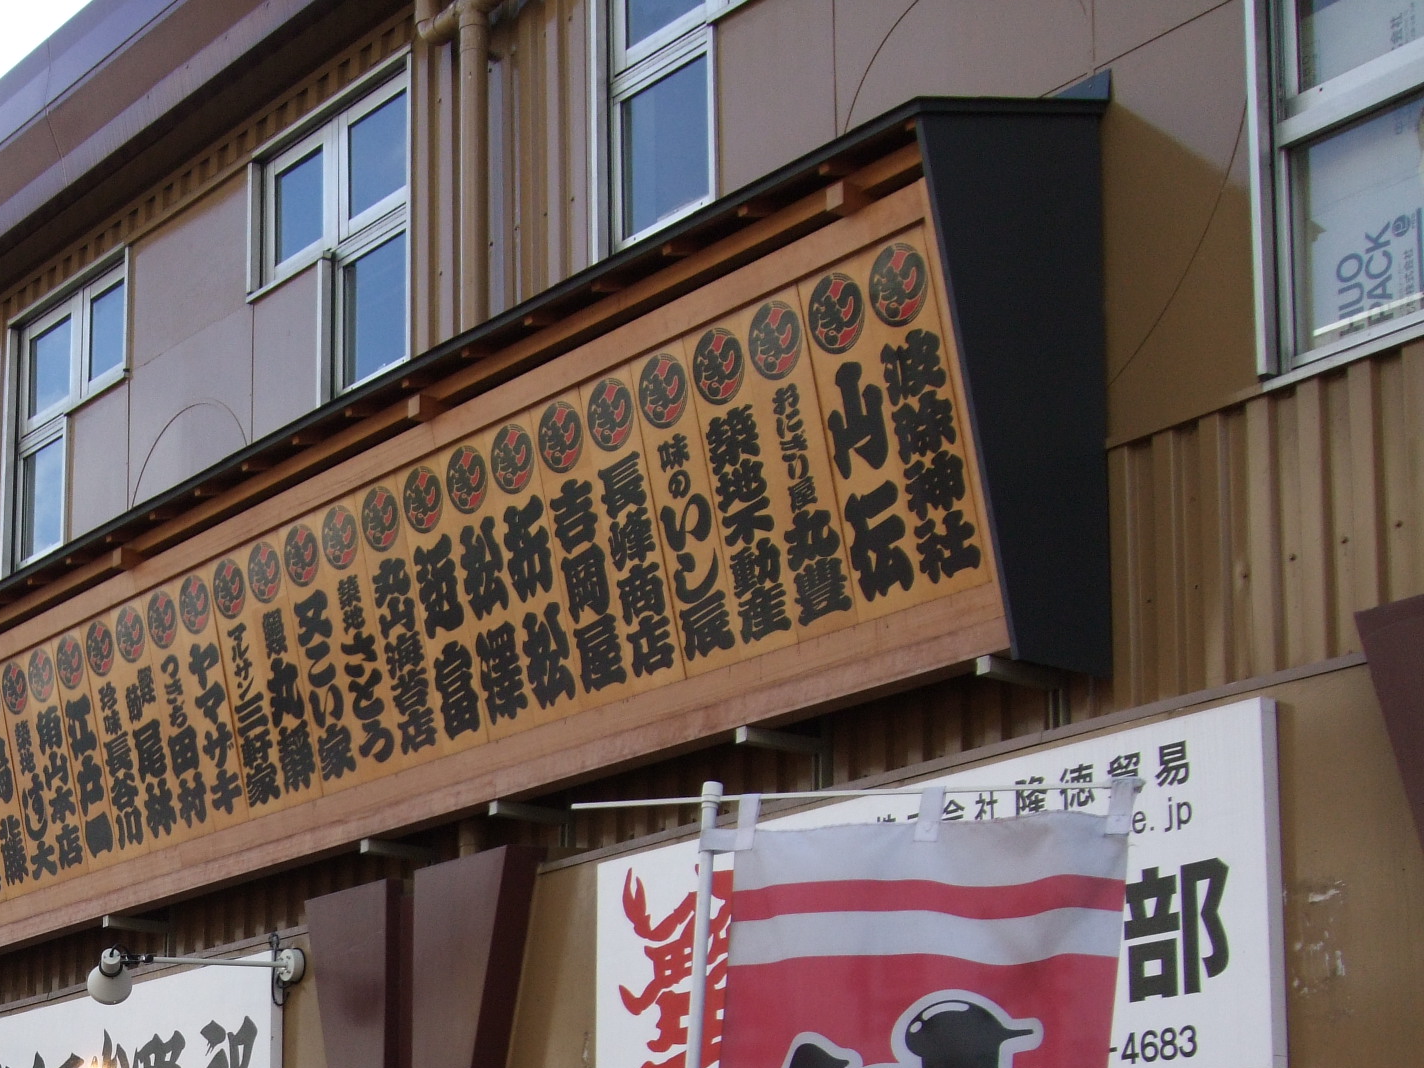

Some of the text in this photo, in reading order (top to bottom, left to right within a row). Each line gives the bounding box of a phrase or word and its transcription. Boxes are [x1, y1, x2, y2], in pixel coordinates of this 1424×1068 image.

[598, 452, 673, 675] 長峰商店
[707, 405, 790, 641] 築地不動産
[773, 384, 851, 625] おにぎり屋丸豊
[828, 362, 913, 600] 山伝
[881, 330, 980, 581] 波除神社
[373, 558, 435, 753] 丸山海苔店
[550, 480, 625, 691] 吉岡屋
[188, 643, 242, 813] ヤマザキ
